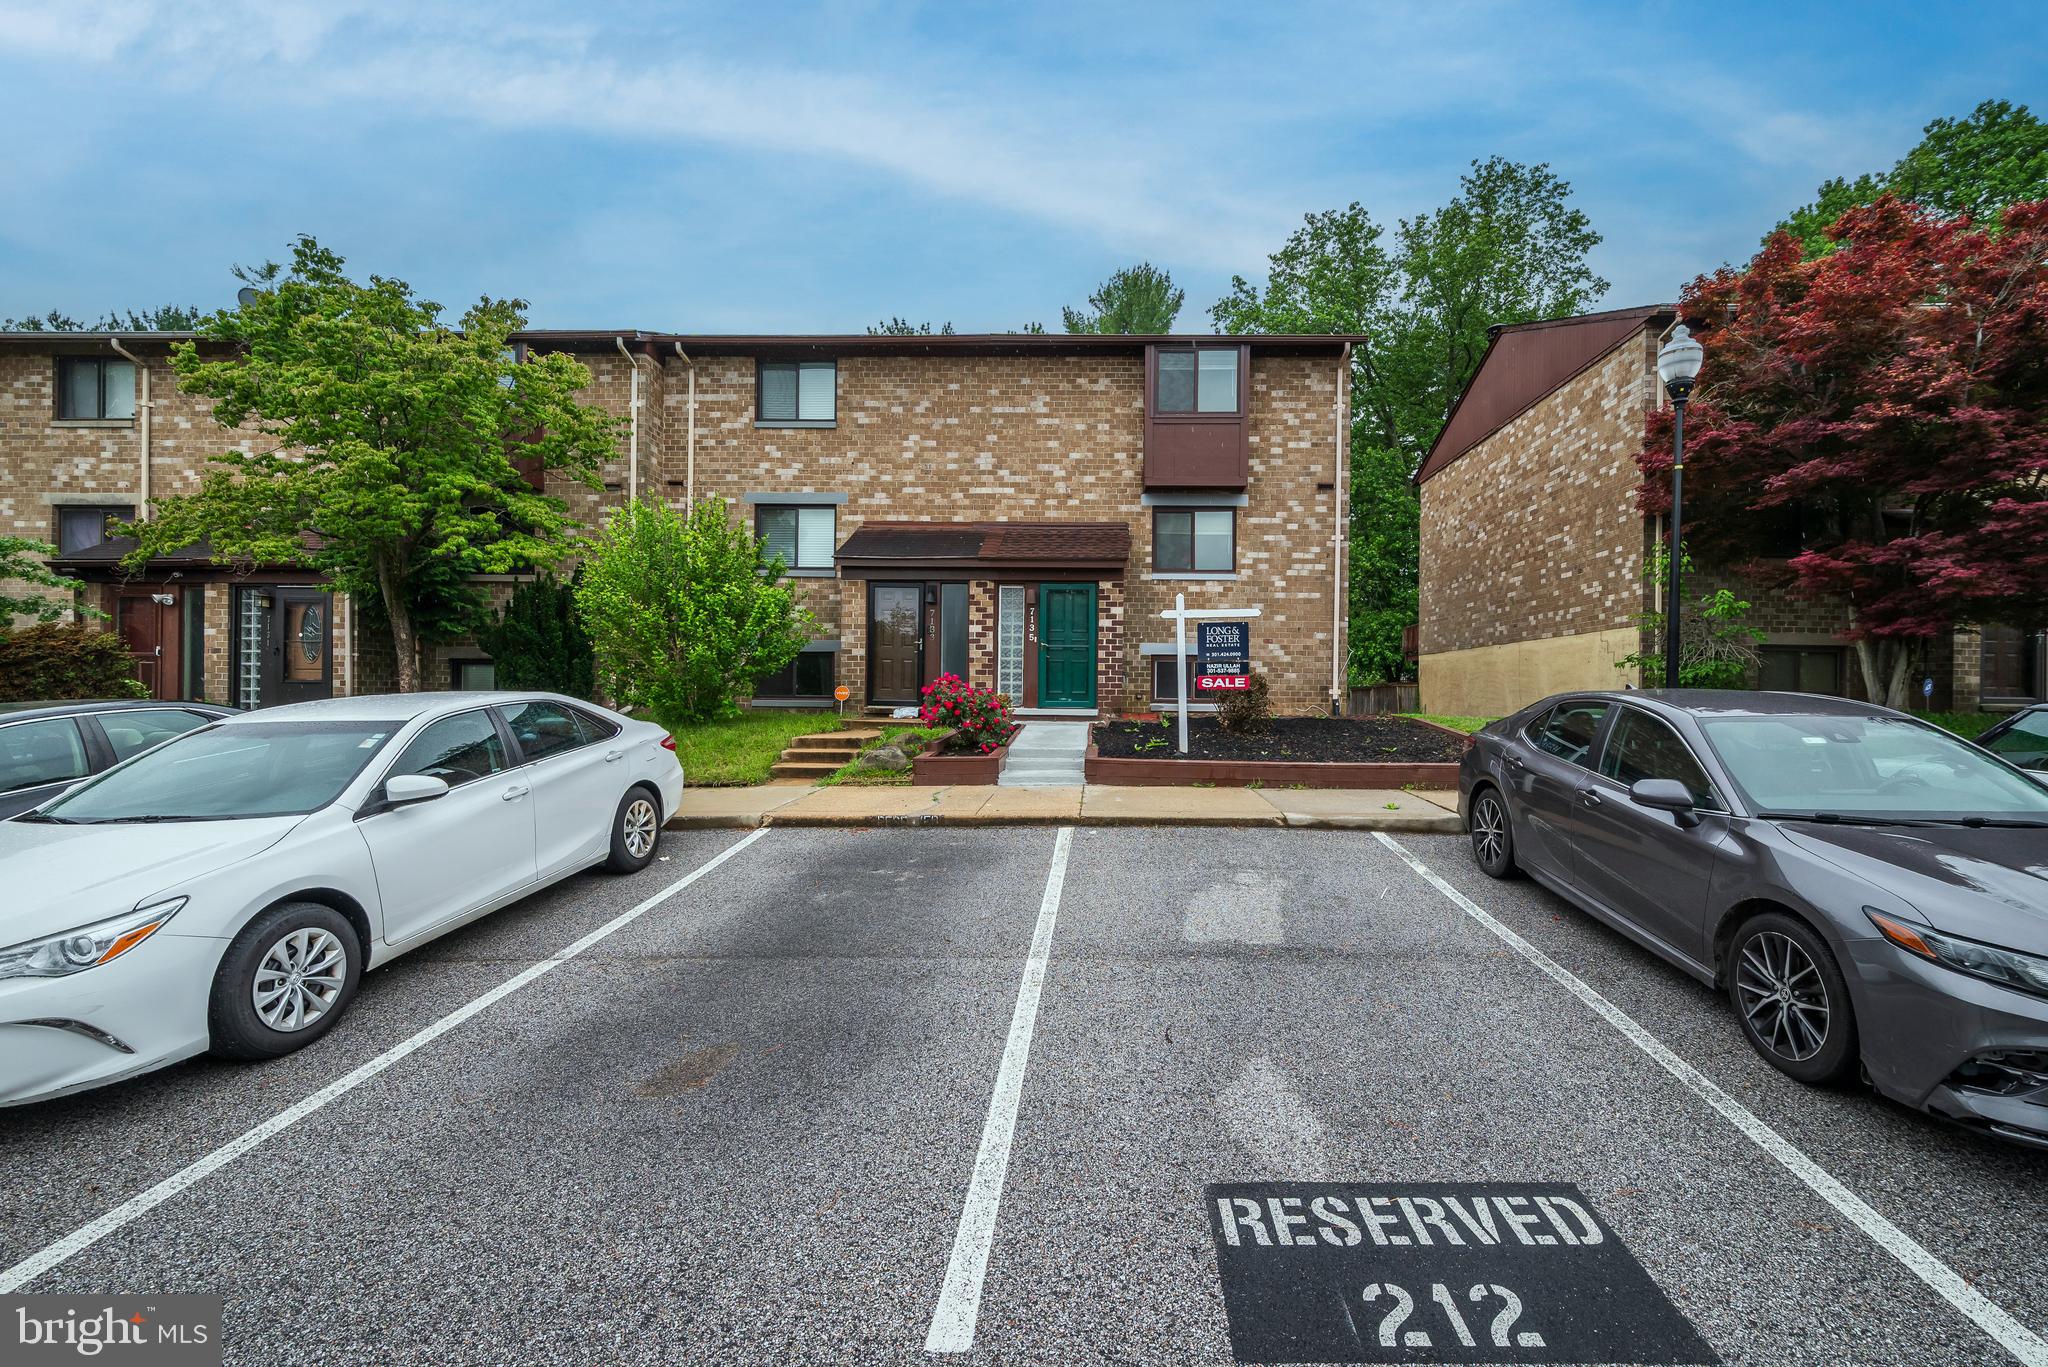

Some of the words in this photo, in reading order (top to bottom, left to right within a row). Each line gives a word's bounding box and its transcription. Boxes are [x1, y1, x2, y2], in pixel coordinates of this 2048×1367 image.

[1206, 626, 1231, 634] LONG
[1232, 626, 1240, 634] &
[1206, 635, 1240, 643] FOSTER
[1202, 678, 1245, 687] SALE
[1217, 1197, 1604, 1246] RESERVED
[1362, 1283, 1546, 1347] 212
